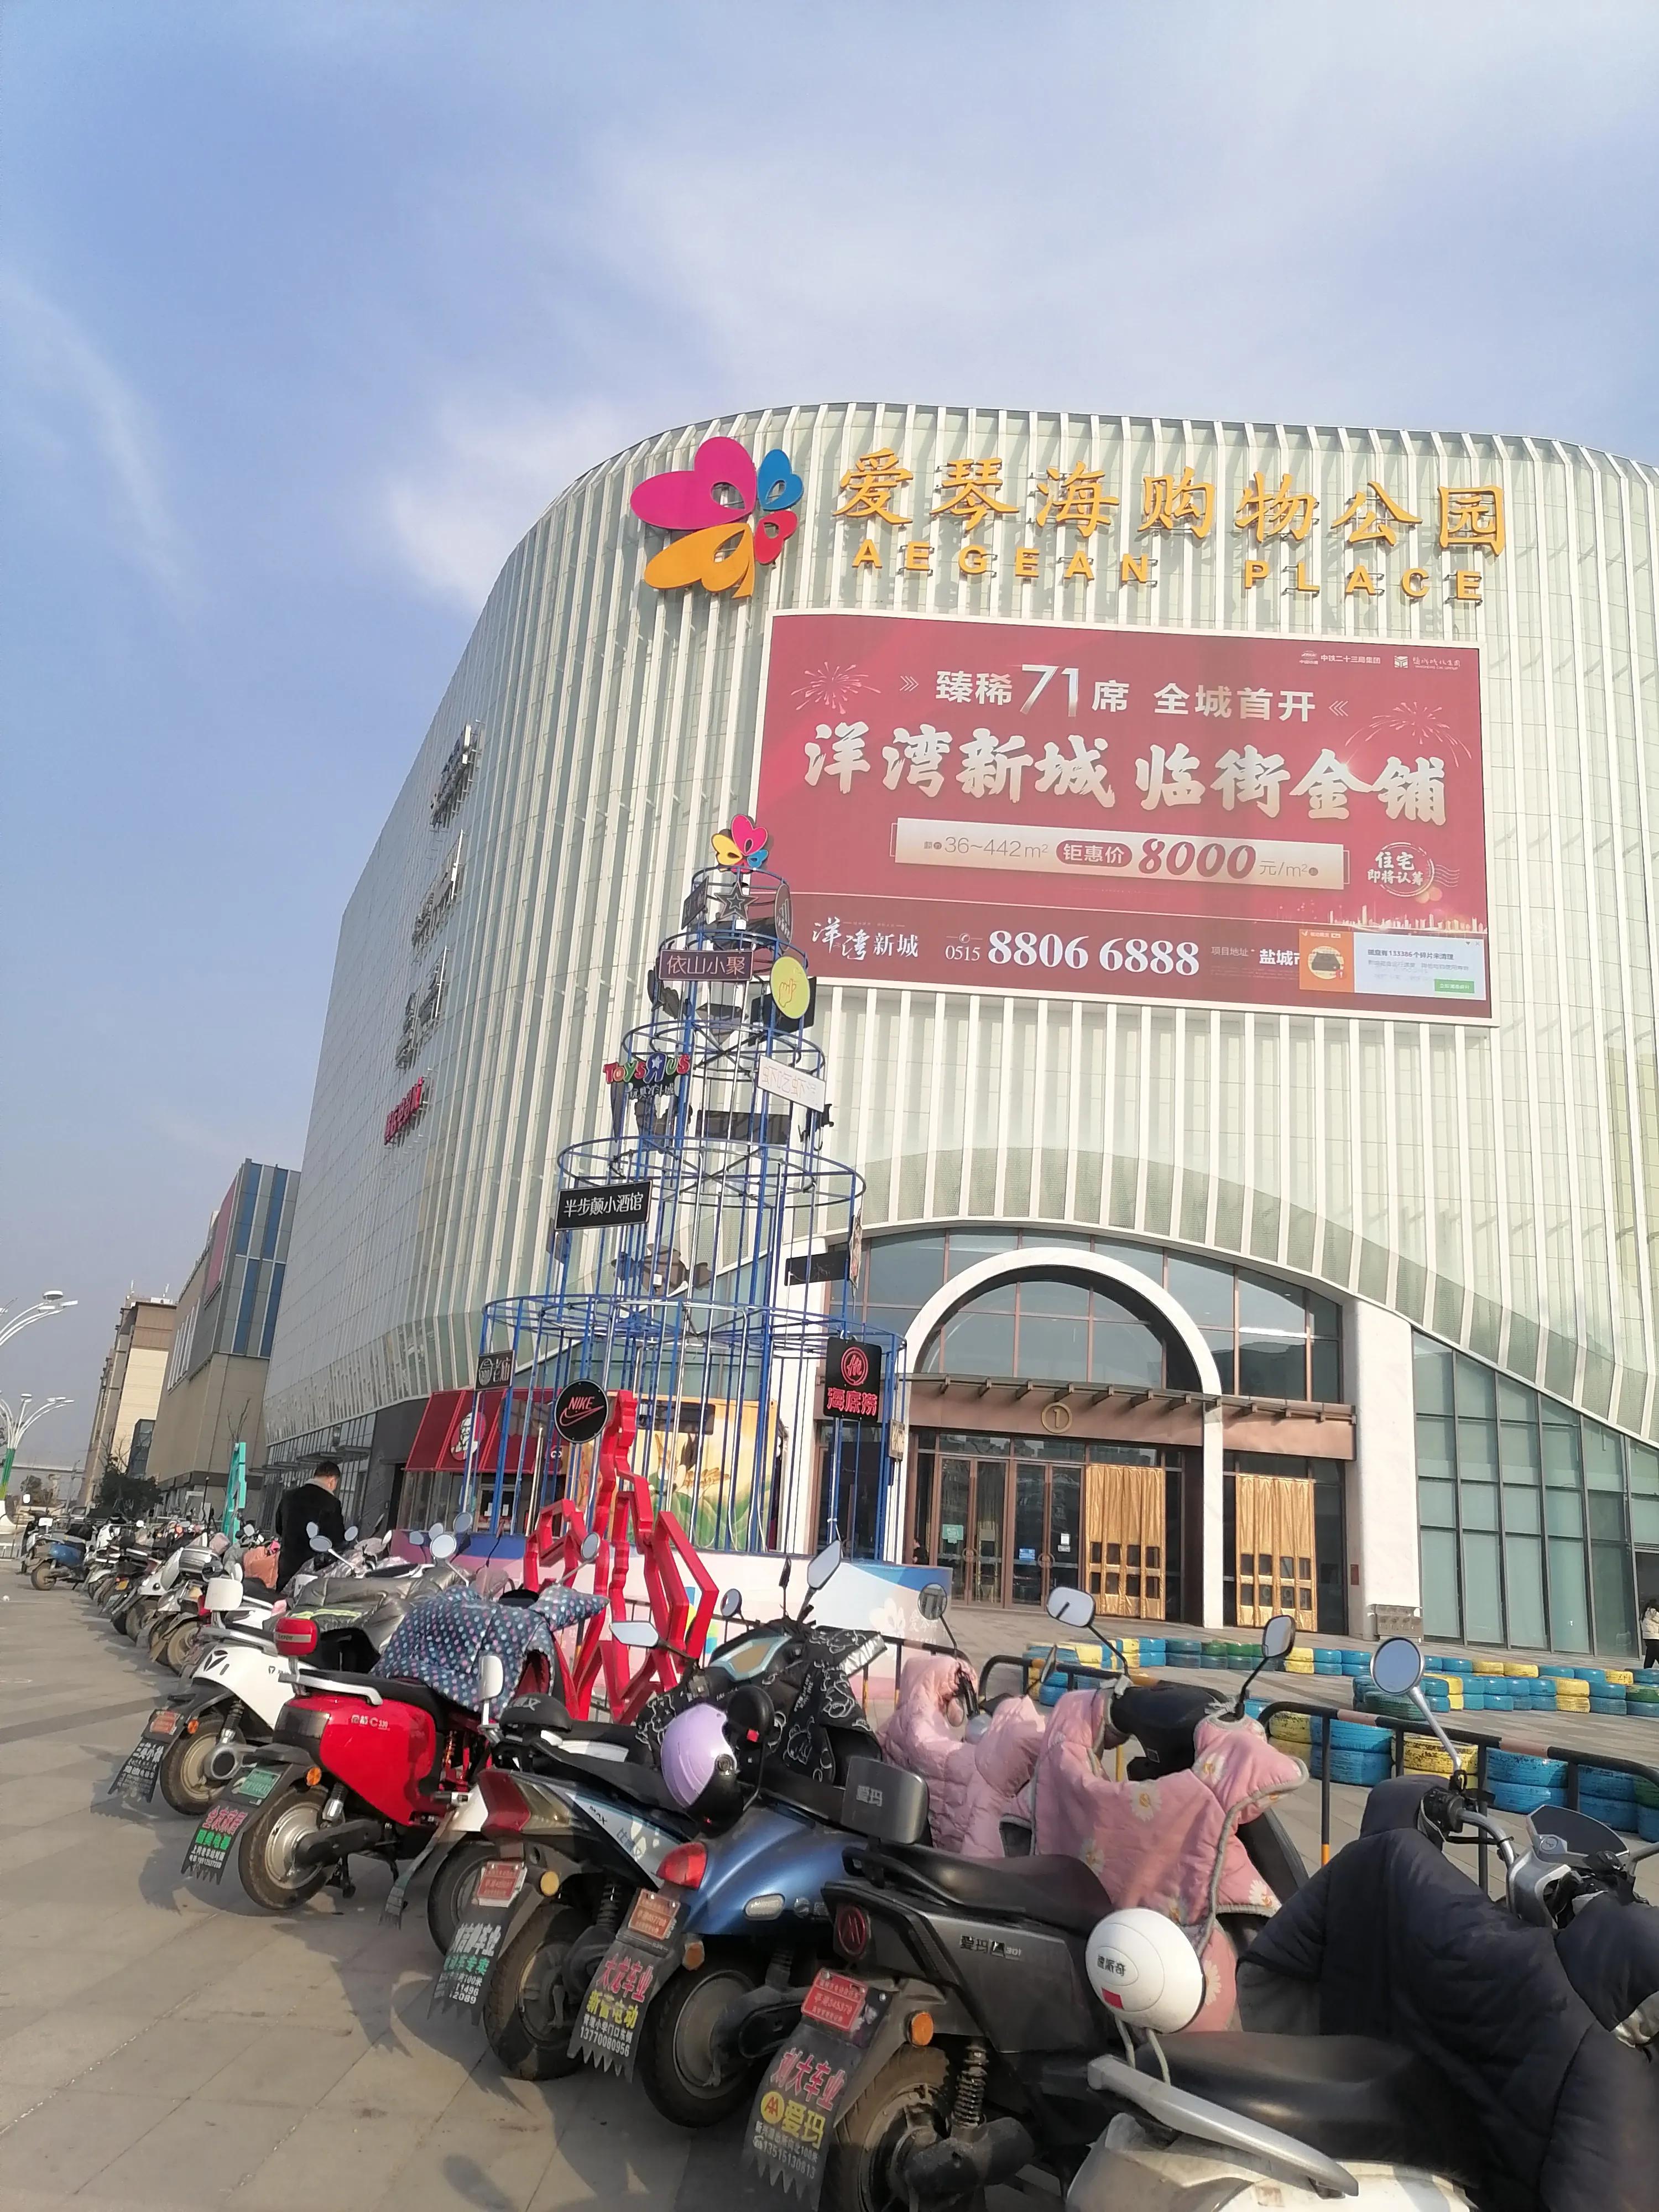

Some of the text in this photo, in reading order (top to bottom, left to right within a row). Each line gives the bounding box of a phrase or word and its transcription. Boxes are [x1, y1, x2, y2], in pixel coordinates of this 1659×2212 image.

[833, 447, 1504, 556] 爱琴海购物公园
[852, 539, 1482, 601] AEGEAN PLACE
[1154, 682, 1316, 722] 全城首开
[804, 721, 1446, 826] 洋湾新城 临街金铺
[1063, 843, 1125, 864] 钜惠价
[1138, 838, 1256, 879] 8000
[1375, 851, 1415, 870] 住宅
[1367, 869, 1423, 886] 即将认筹
[667, 955, 745, 975] 依山小聚
[945, 945, 980, 962] 0515
[988, 931, 1089, 969] 8806
[1099, 936, 1200, 976] 6888
[1211, 946, 1249, 957] 项目地址
[563, 1191, 642, 1218] 半步颠小酒馆
[567, 1395, 593, 1411] NIKE
[827, 1386, 878, 1416] 海底捞
[781, 2099, 826, 2150] 爱玛
